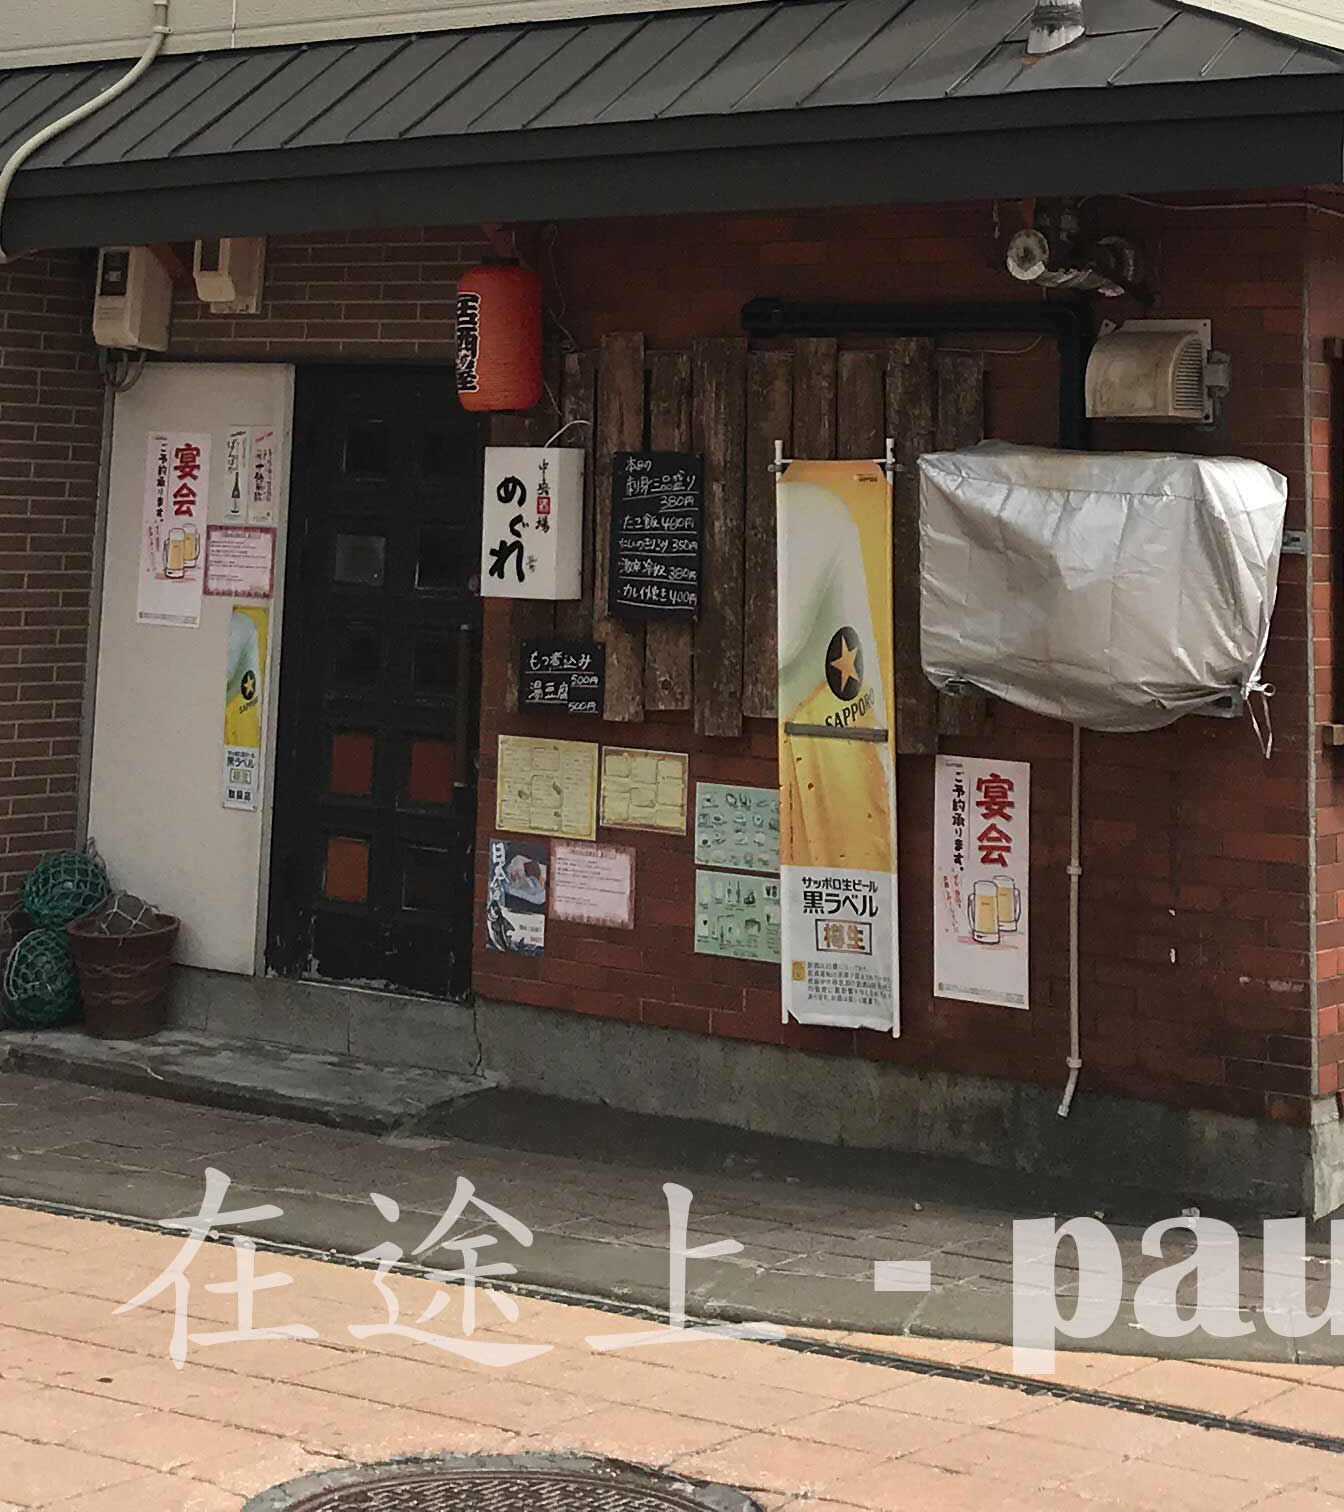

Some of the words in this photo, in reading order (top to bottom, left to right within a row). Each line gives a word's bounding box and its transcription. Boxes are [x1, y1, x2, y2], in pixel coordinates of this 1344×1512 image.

[625, 456, 653, 473] 本日の
[173, 443, 201, 518] 宴会
[488, 476, 530, 583] めぐれ
[529, 650, 593, 671] もつ煮込み
[570, 674, 599, 686] 500円
[567, 701, 597, 712] 500円
[952, 771, 965, 872] ご予約承ります。
[976, 773, 1015, 868] 宴会
[801, 876, 878, 894] サッポロ生ビール
[803, 890, 879, 918] 黒ラベル
